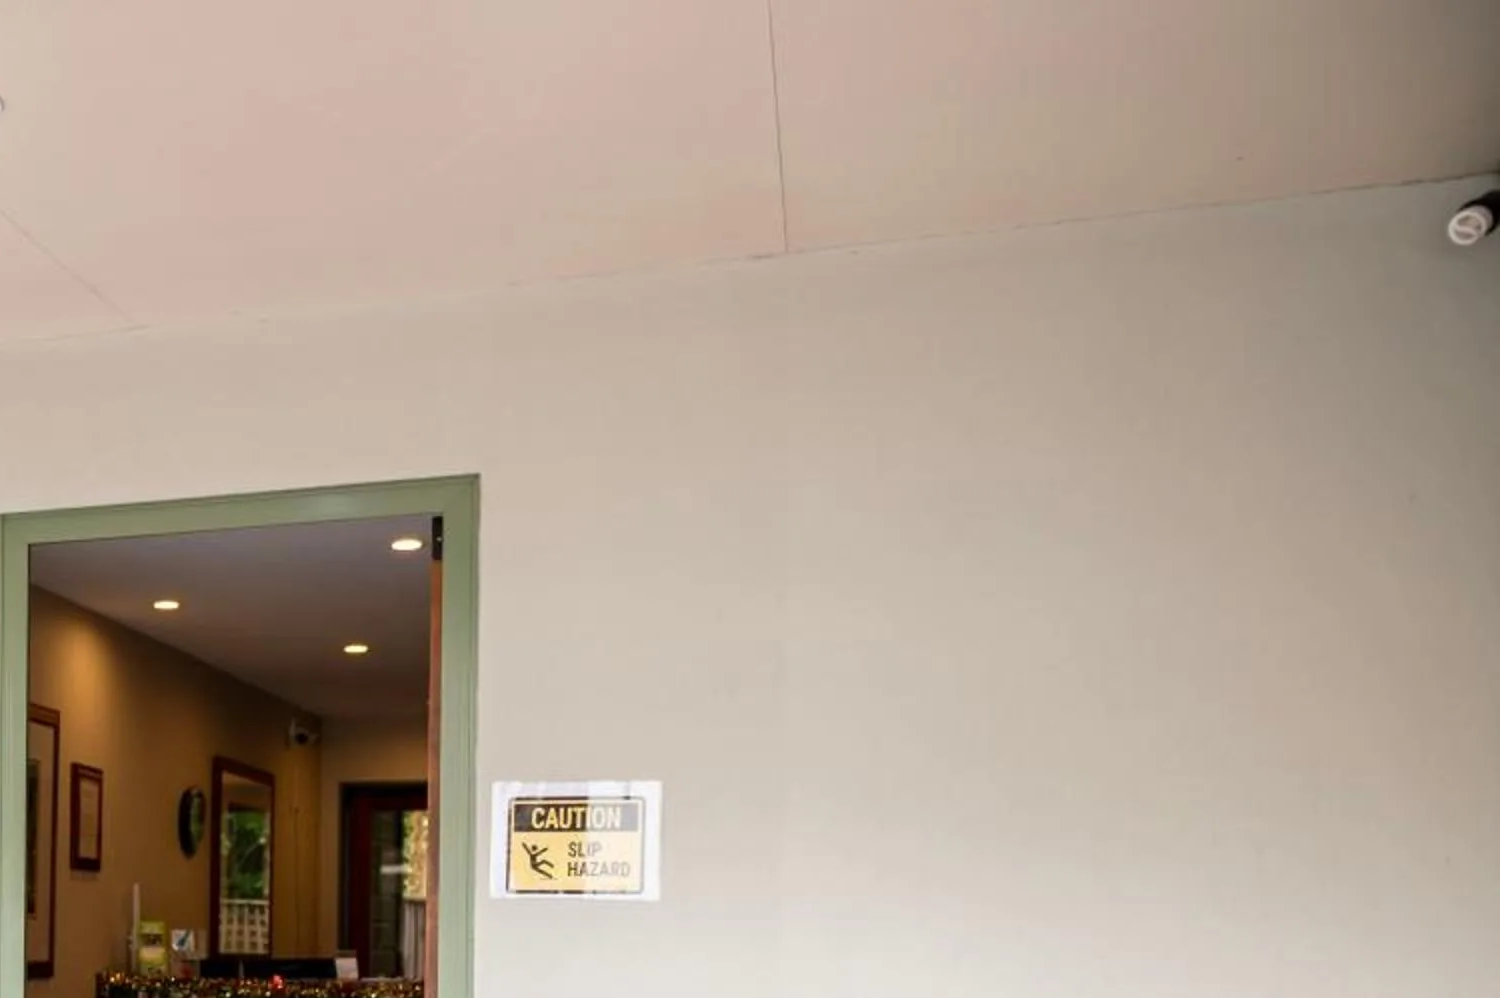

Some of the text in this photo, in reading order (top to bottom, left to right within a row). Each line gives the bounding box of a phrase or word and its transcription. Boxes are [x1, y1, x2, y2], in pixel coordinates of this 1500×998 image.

[531, 807, 622, 829] CAUTION
[567, 841, 603, 857] SLIP
[567, 861, 631, 878] HAZARD
